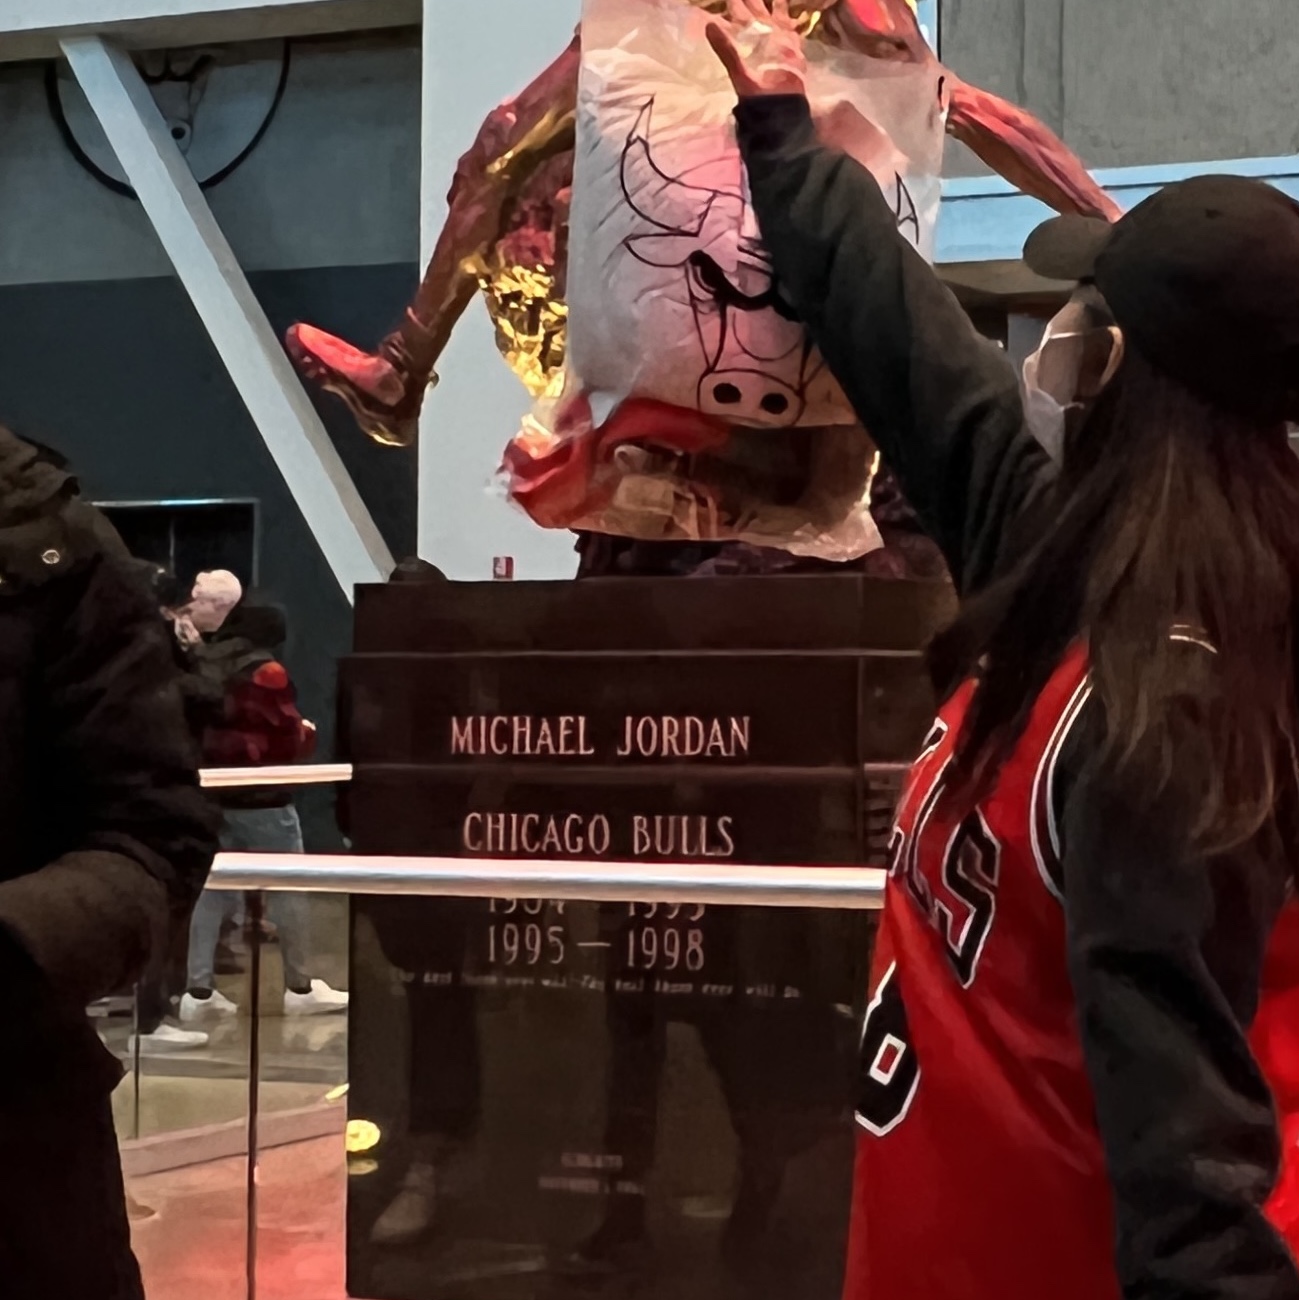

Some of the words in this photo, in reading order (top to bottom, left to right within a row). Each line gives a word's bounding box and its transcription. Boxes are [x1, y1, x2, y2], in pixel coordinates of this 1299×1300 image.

[451, 715, 594, 756] MICHAEL
[616, 716, 751, 757] JORDAN
[463, 812, 610, 854] CHICAGO
[633, 814, 735, 857] BULLS
[488, 922, 565, 966] 1995
[627, 926, 705, 971] 1998
